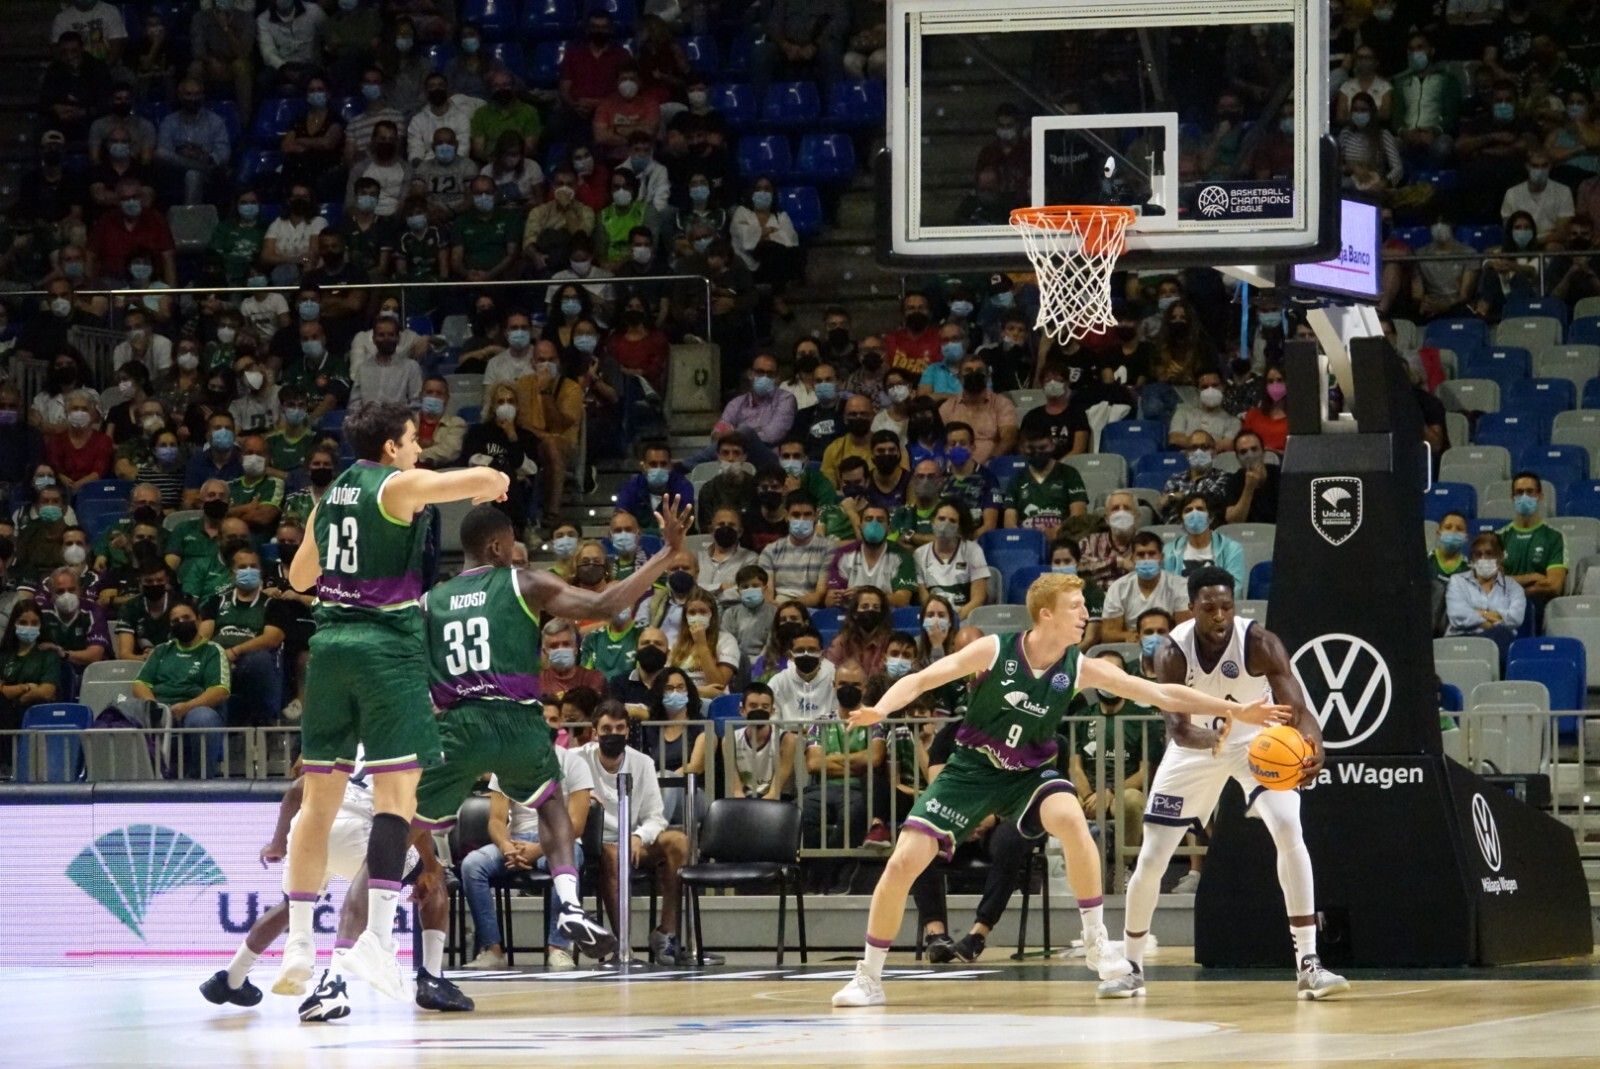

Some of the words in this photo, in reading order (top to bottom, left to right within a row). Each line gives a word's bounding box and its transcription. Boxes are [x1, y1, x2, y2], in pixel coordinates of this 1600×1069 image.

[1230, 188, 1283, 197] BASKETBALL
[1230, 196, 1290, 205] CHAMPIONS
[1230, 205, 1263, 213] LEAGUE
[1348, 244, 1370, 266] Banco
[1322, 509, 1351, 519] Unicaja
[443, 616, 491, 676] 33
[1005, 724, 1023, 748] 9
[1337, 763, 1424, 789] Wagen
[1153, 796, 1182, 811] Plus
